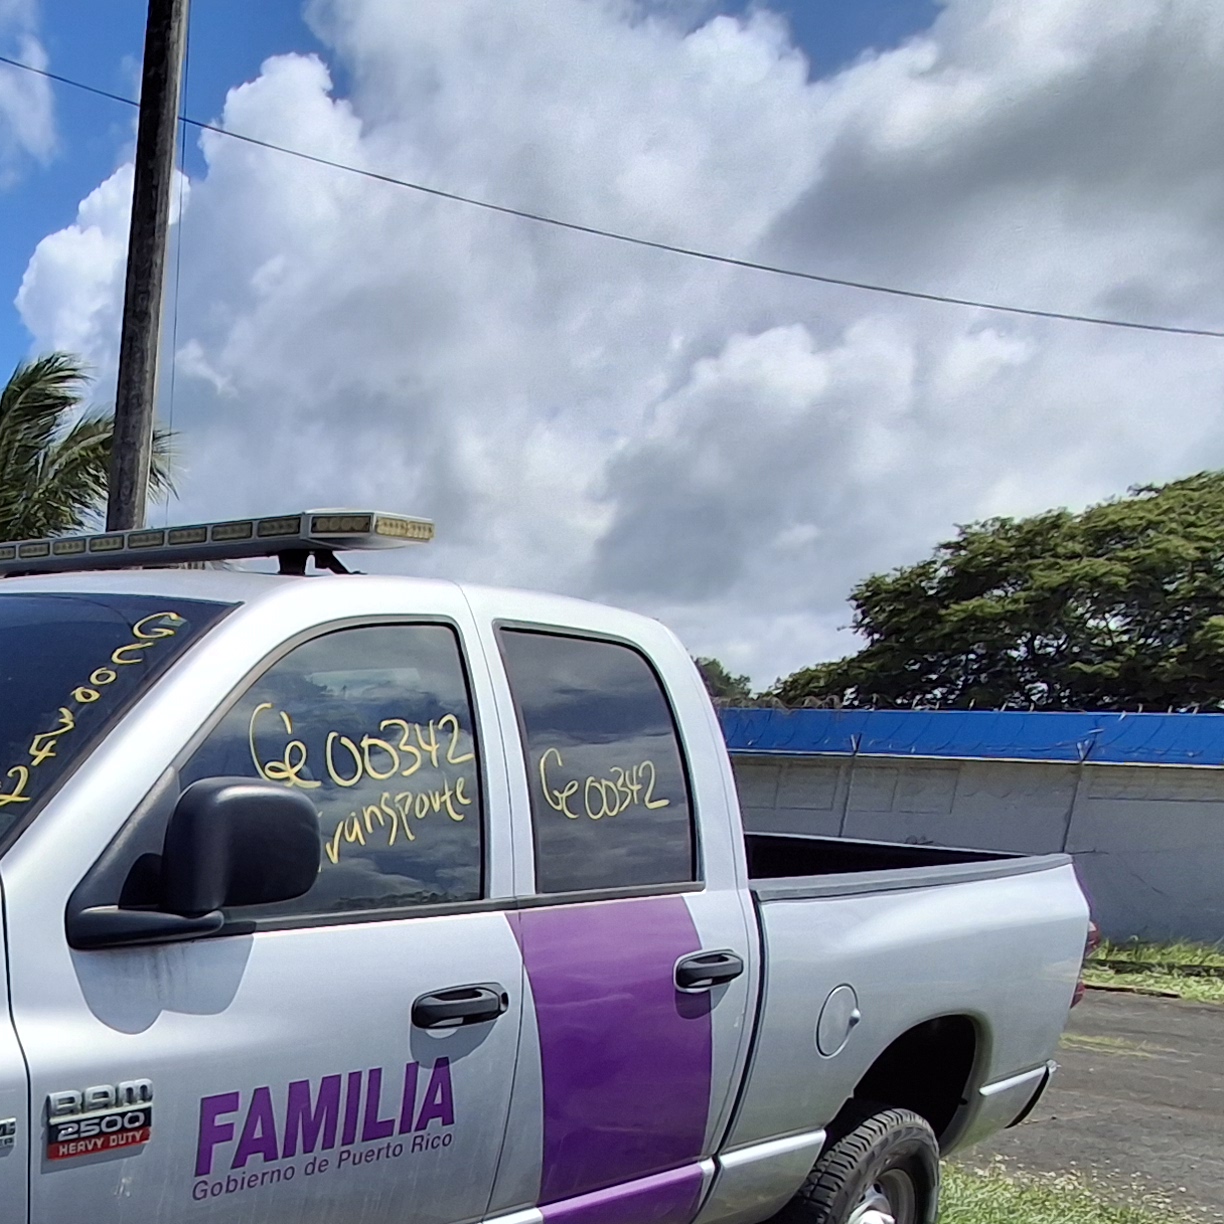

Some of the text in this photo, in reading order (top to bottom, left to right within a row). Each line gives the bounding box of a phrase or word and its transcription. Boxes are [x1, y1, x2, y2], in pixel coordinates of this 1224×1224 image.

[318, 777, 471, 872] ransporte
[57, 1111, 145, 1142] 2500
[58, 1130, 143, 1156] HEAVY DUTY
[194, 1056, 455, 1178] FAMILIA
[192, 1132, 452, 1201] Gobierno de Puerto Rico
